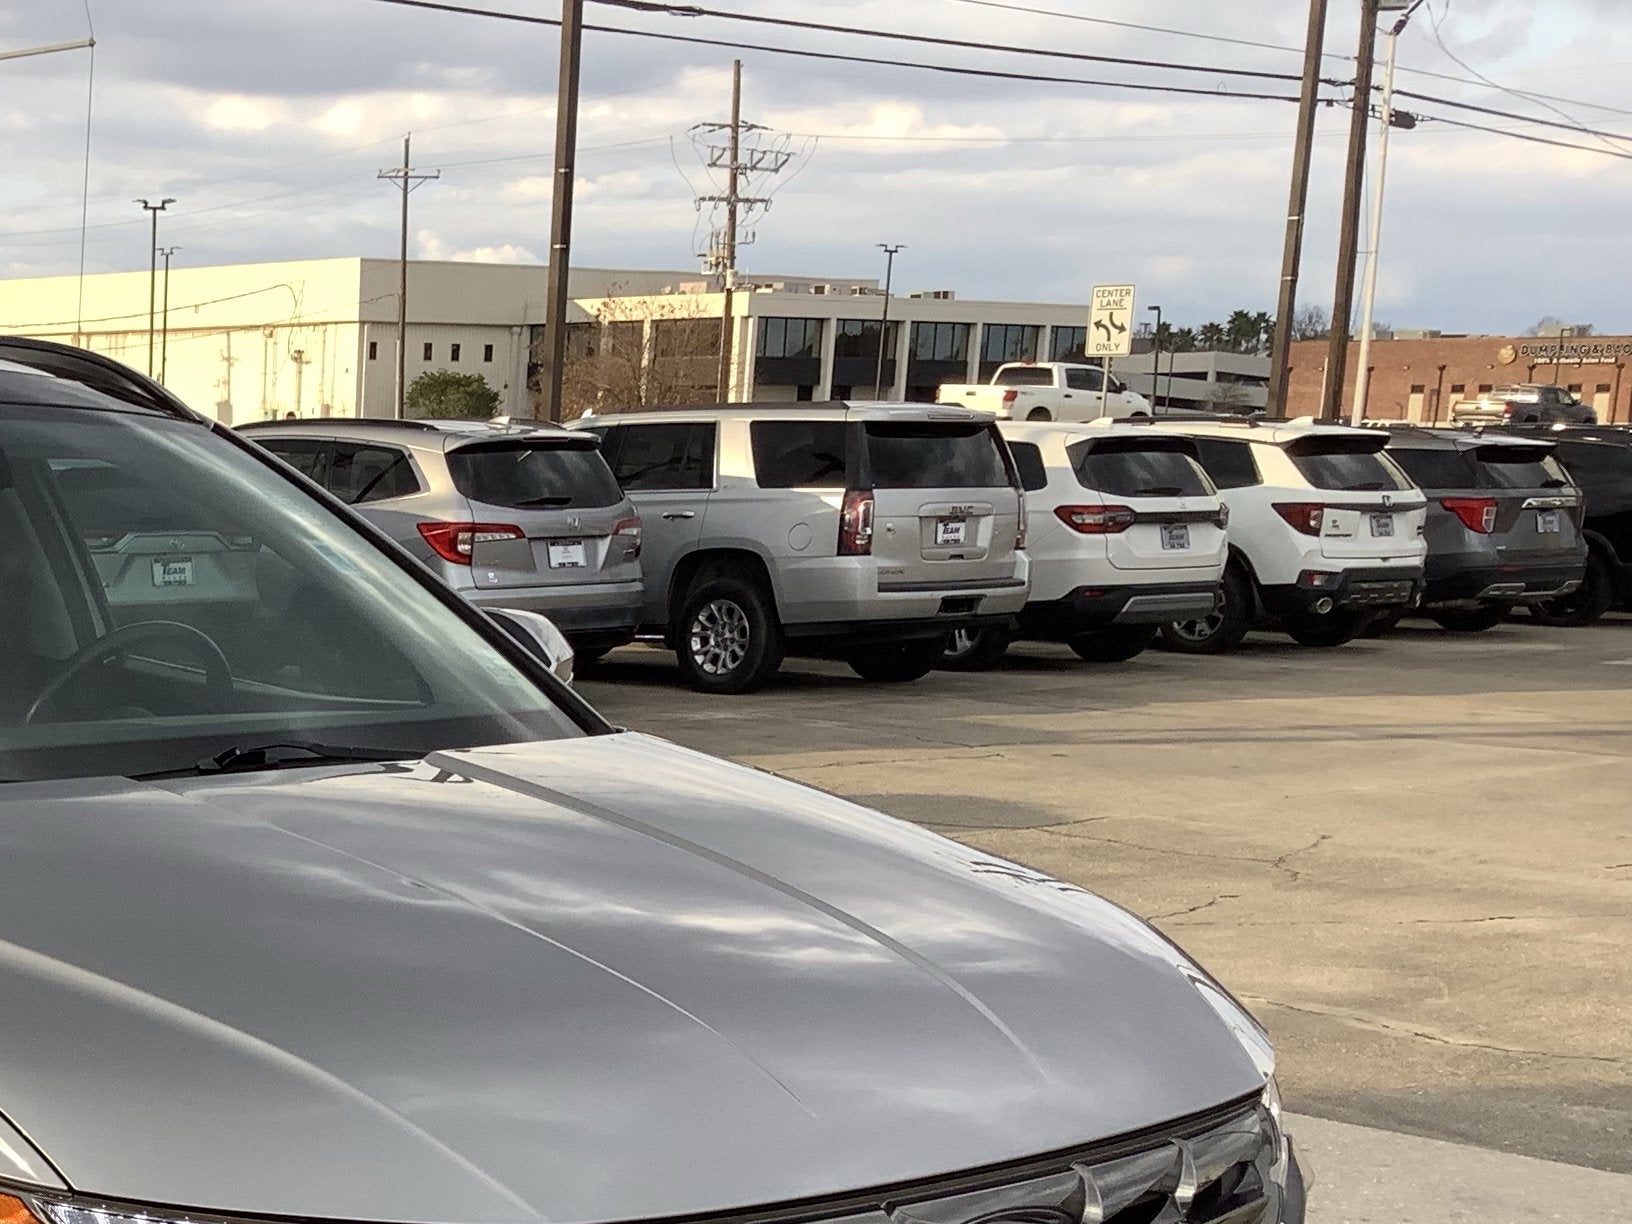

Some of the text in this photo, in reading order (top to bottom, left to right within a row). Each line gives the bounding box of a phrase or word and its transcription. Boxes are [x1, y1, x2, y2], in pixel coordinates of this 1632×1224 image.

[1096, 288, 1131, 298] CENTER
[1100, 299, 1125, 307] LANE
[1096, 343, 1121, 352] ONLY
[943, 523, 961, 534] TEAM
[161, 563, 186, 575] TEAM
